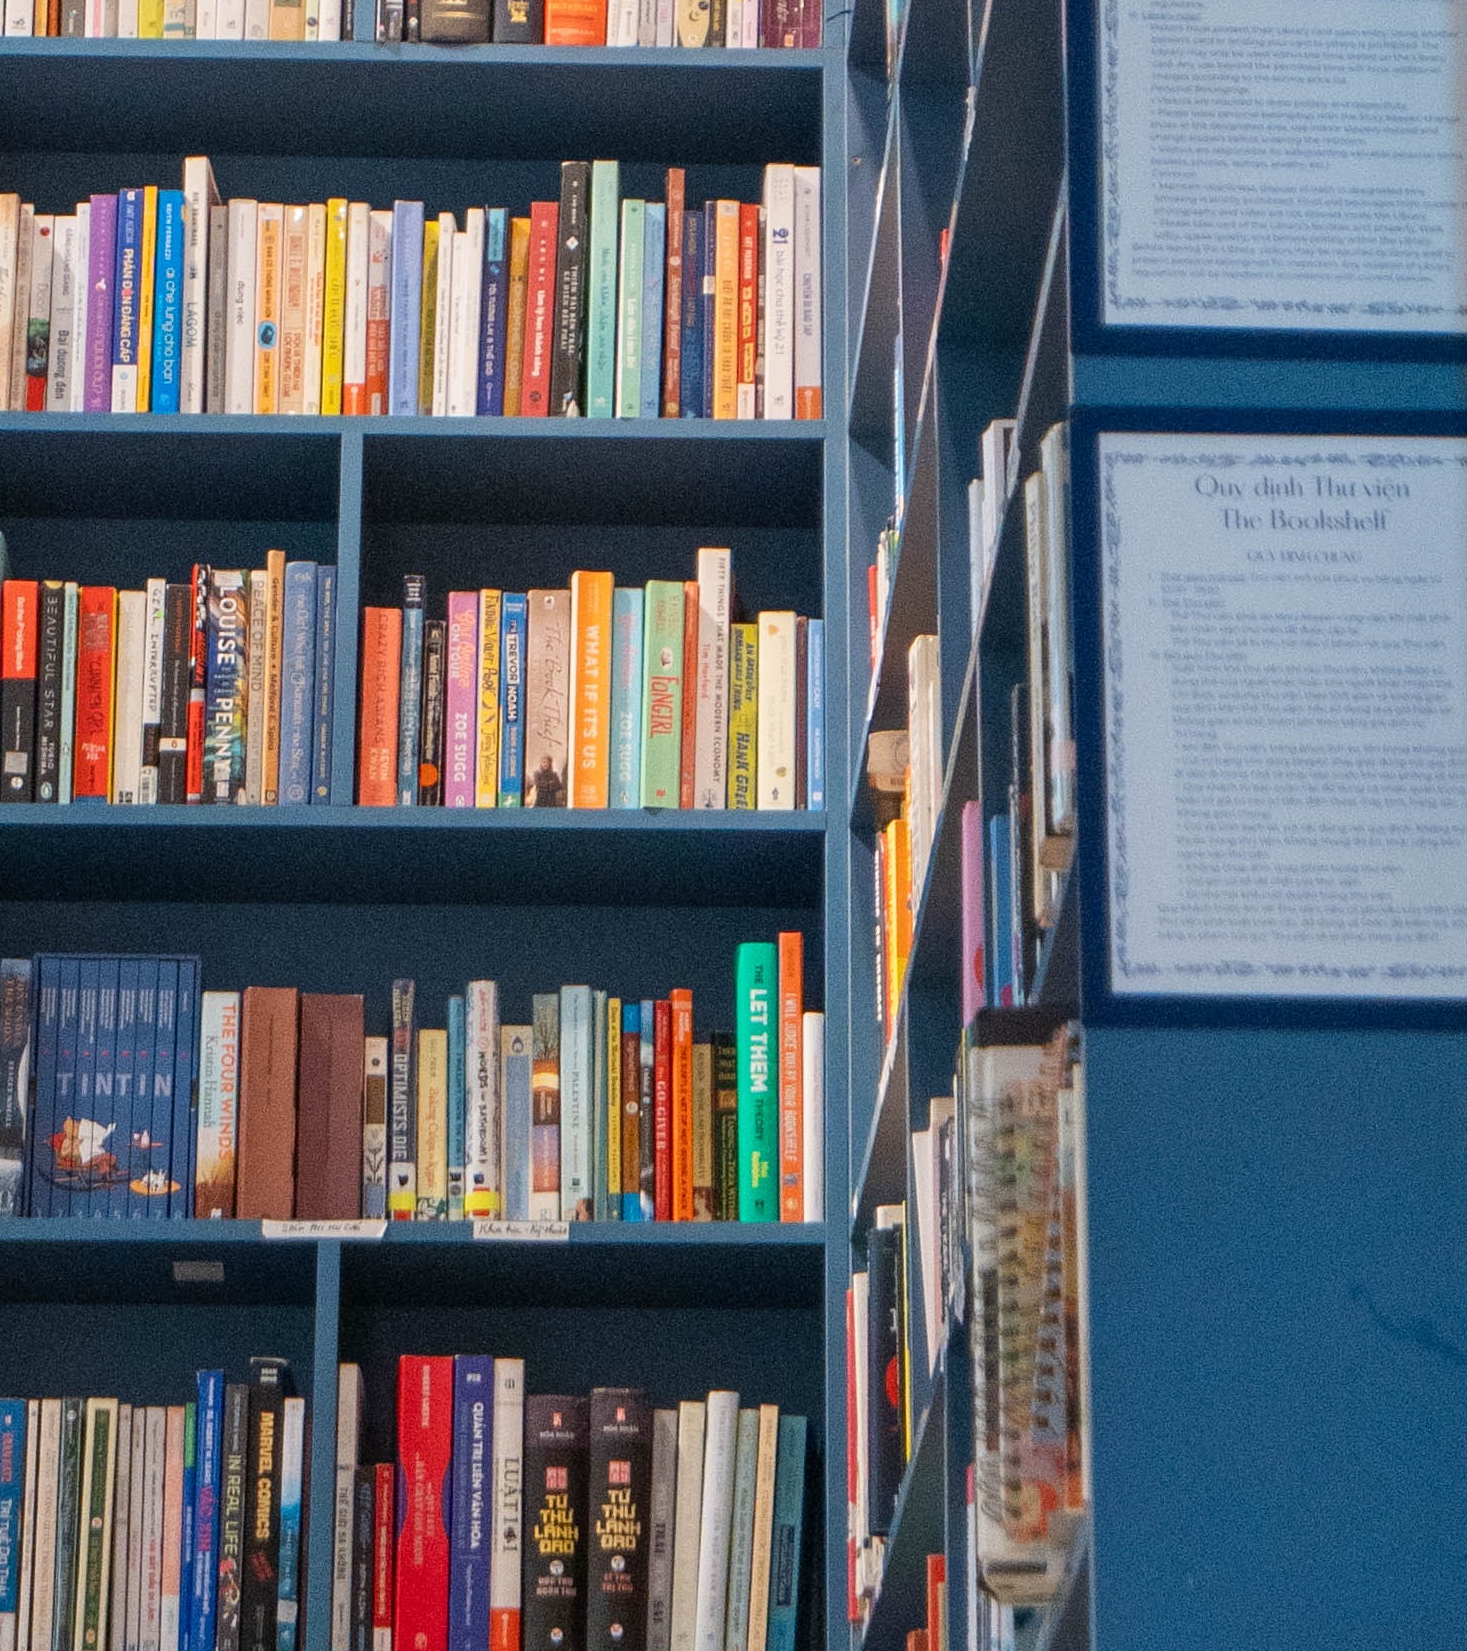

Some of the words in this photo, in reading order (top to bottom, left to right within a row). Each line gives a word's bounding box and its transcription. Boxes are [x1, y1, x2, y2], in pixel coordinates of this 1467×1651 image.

[164, 226, 172, 260] FERRAZZI
[772, 228, 789, 244] 21
[185, 302, 197, 348] LAGOM
[1194, 474, 1243, 498] Quy
[1220, 508, 1261, 530] The
[1270, 509, 1392, 531] Bookshelf
[717, 557, 725, 580] FIFTY
[251, 580, 263, 627] PEACE
[271, 577, 279, 612] Gender
[717, 584, 725, 617] THINGS
[45, 597, 58, 681] BEAUTIFUL
[217, 586, 238, 665] LOUISE
[251, 632, 263, 651] OF
[270, 625, 278, 660] Culture
[376, 614, 389, 656] CRAZY
[450, 623, 460, 643] ON
[544, 623, 563, 651] The
[716, 620, 724, 641] THAT
[450, 646, 460, 679] TOUR
[507, 635, 519, 684] TREVOR
[585, 625, 600, 678] WHAT
[701, 643, 710, 659] Tim
[716, 645, 724, 670] MADE
[746, 643, 755, 657] AN
[148, 633, 158, 713] INTERRUPTED
[251, 654, 263, 691] MIND
[375, 661, 388, 695] RICH
[541, 655, 564, 698] Book
[701, 662, 710, 698] Harford
[715, 674, 723, 690] THE
[44, 689, 56, 728] STAR
[269, 674, 277, 711] Melford
[507, 685, 517, 721] NOAH
[584, 684, 598, 701] IF
[650, 675, 679, 738] FANGIRL
[269, 714, 276, 723] E.
[374, 697, 387, 744] ASIANS
[454, 712, 467, 739] ZOE
[537, 701, 563, 749] Thief
[583, 708, 598, 739] IT'S
[620, 712, 633, 739] ZOE
[714, 694, 722, 733] MODERN
[214, 698, 233, 773] PENNY
[267, 725, 276, 751] Spiro
[736, 732, 750, 770] HANK
[40, 735, 48, 775] MISHIMA
[47, 741, 55, 769] YUKIO
[368, 747, 379, 780] KWAN
[379, 748, 390, 781] KEVIN
[453, 743, 466, 782] SUGG
[582, 745, 596, 769] US
[619, 743, 632, 781] SUGG
[713, 736, 722, 782] ECONOMY
[754, 965, 764, 985] THE
[221, 1003, 236, 1039] THE
[750, 988, 768, 1026] LET
[784, 998, 798, 1018] WILL
[784, 1022, 798, 1050] JUDGE
[204, 1035, 218, 1077] Kristin
[220, 1044, 235, 1094] FOUR
[478, 1051, 488, 1088] WORDS
[750, 1032, 768, 1093] THEM
[784, 1052, 798, 1068] YOU
[57, 1071, 172, 1097] TINTIN
[393, 1053, 409, 1132] OPTIMISTS
[571, 1071, 580, 1129] PALESTINE
[784, 1084, 798, 1108] YOUR
[203, 1080, 216, 1128] Hannah
[656, 1081, 667, 1150] GO-GIVER
[754, 1099, 764, 1141] THEORY
[218, 1098, 234, 1160] WINDS
[783, 1110, 798, 1162] BOOKSHELF
[393, 1136, 407, 1160] DIE
[258, 1410, 274, 1475] MARVEL
[229, 1454, 241, 1470] IN
[226, 1474, 240, 1515] REAL
[255, 1477, 271, 1540] COMICS
[224, 1520, 239, 1557] LIFE
